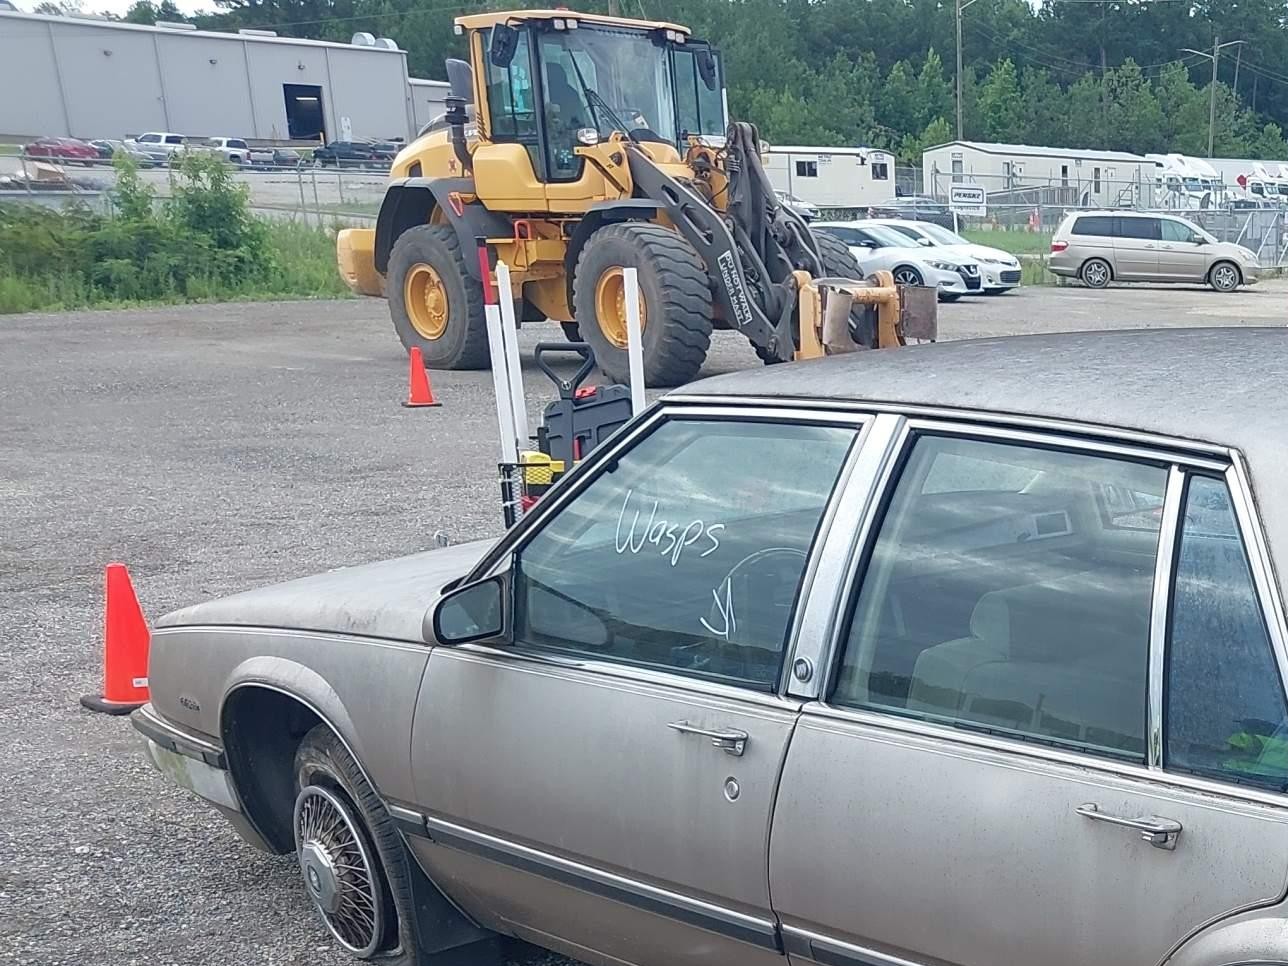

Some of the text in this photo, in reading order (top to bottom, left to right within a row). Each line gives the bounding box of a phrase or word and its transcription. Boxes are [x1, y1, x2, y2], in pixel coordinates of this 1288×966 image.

[953, 191, 981, 199] PENSKE
[738, 289, 752, 321] WALK
[615, 489, 726, 567] Wasps
